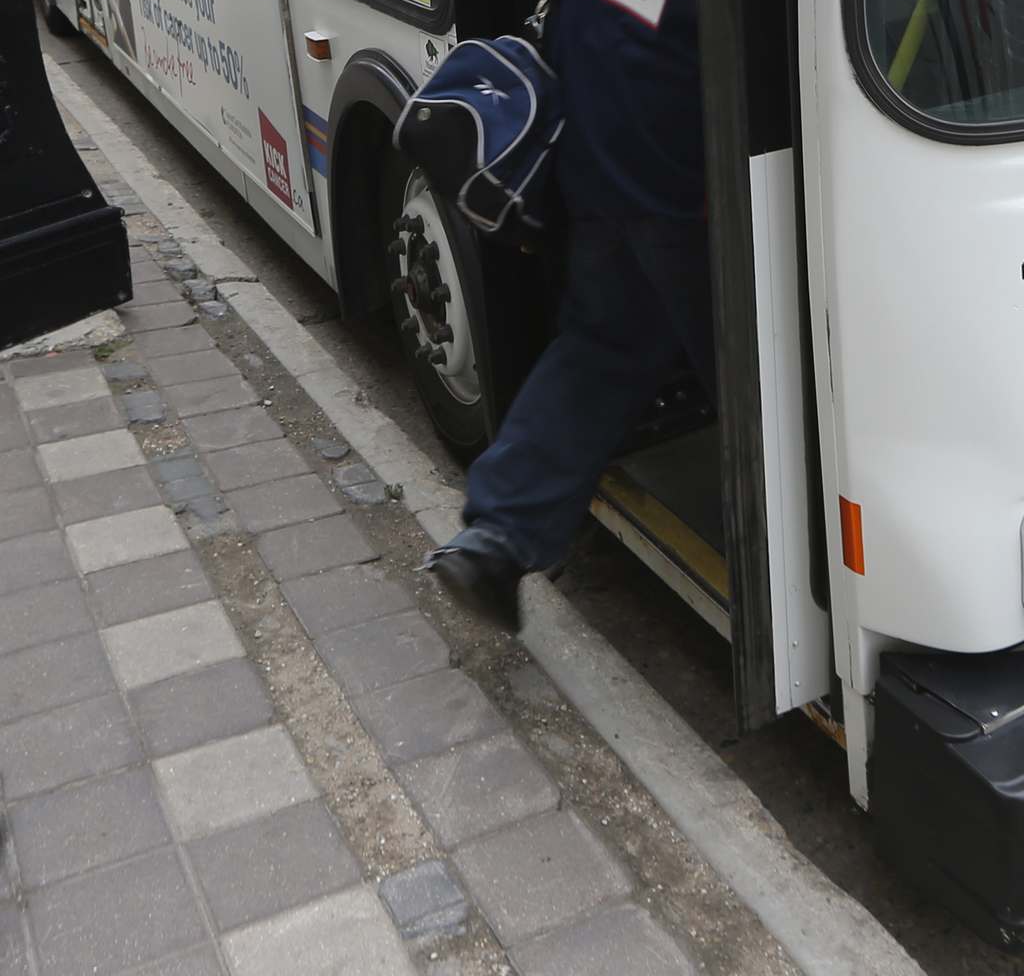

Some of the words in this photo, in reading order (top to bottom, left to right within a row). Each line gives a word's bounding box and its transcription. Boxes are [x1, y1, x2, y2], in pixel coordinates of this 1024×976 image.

[163, 9, 194, 54] cancer
[194, 31, 208, 73] up
[207, 36, 221, 76] to
[218, 39, 249, 100] 50%
[263, 140, 287, 180] KICK
[267, 167, 290, 198] CANCER
